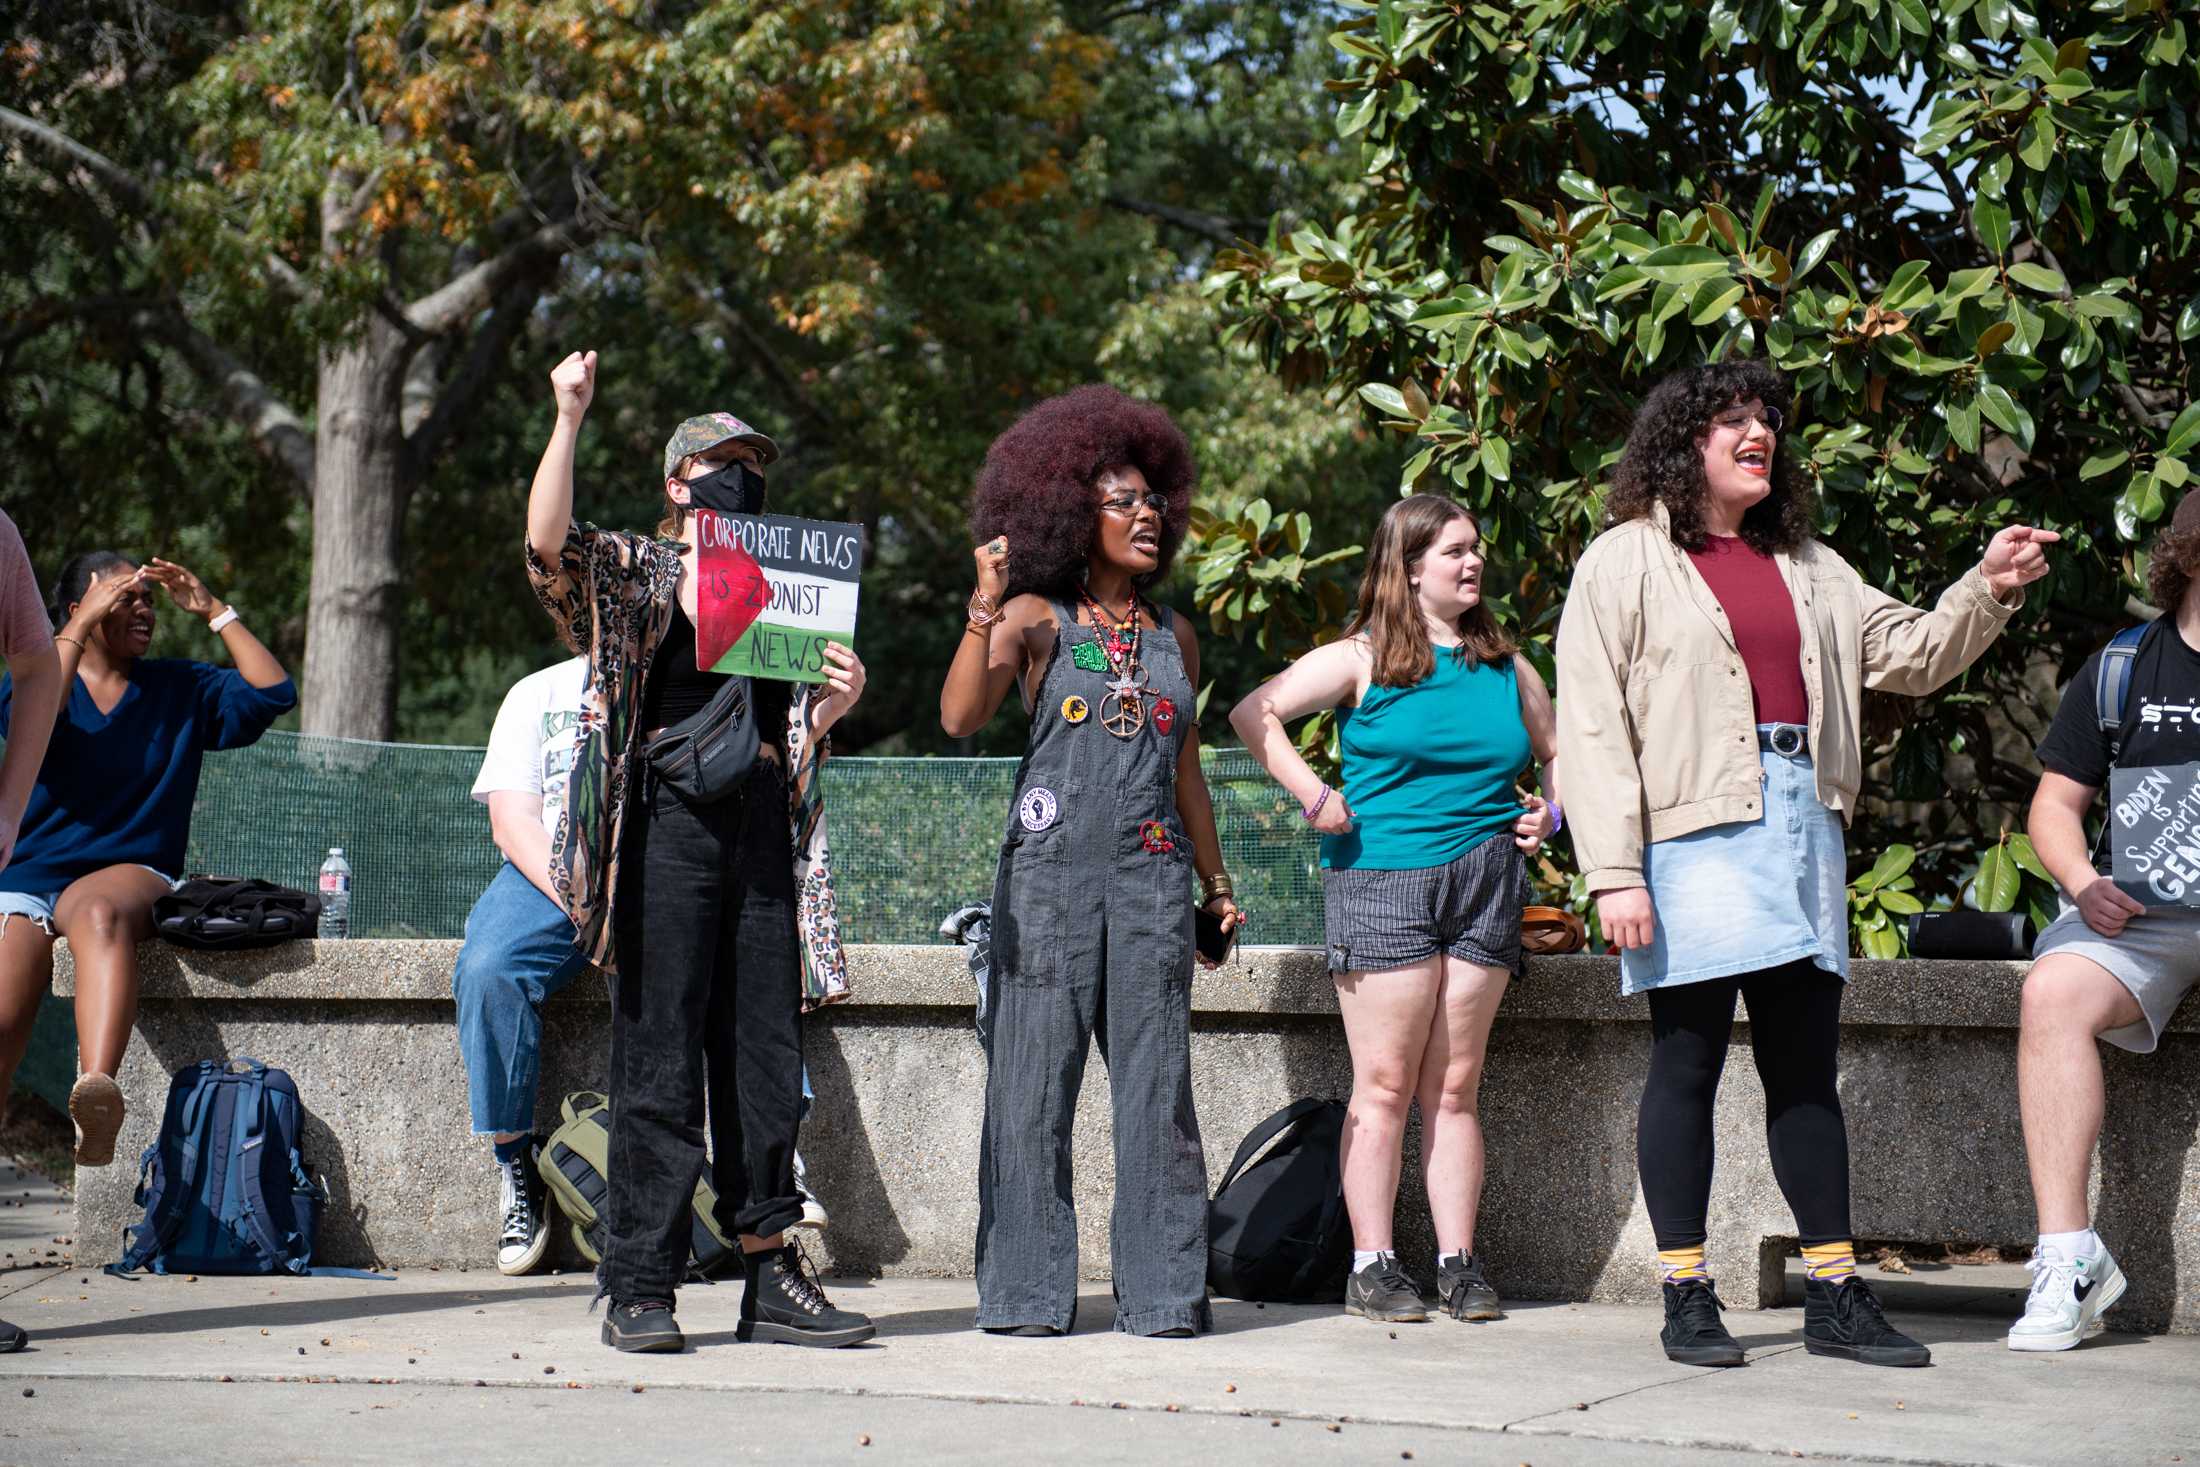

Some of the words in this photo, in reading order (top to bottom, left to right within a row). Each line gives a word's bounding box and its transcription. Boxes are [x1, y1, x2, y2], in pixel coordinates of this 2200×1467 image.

[701, 514, 792, 560] CORPORATE
[800, 528, 858, 570] NEWS
[711, 569, 730, 599] IS
[744, 575, 829, 616] ZIONIST
[750, 629, 829, 673] NEWS
[2115, 767, 2173, 829] BIDEN
[2150, 803, 2173, 822] IS
